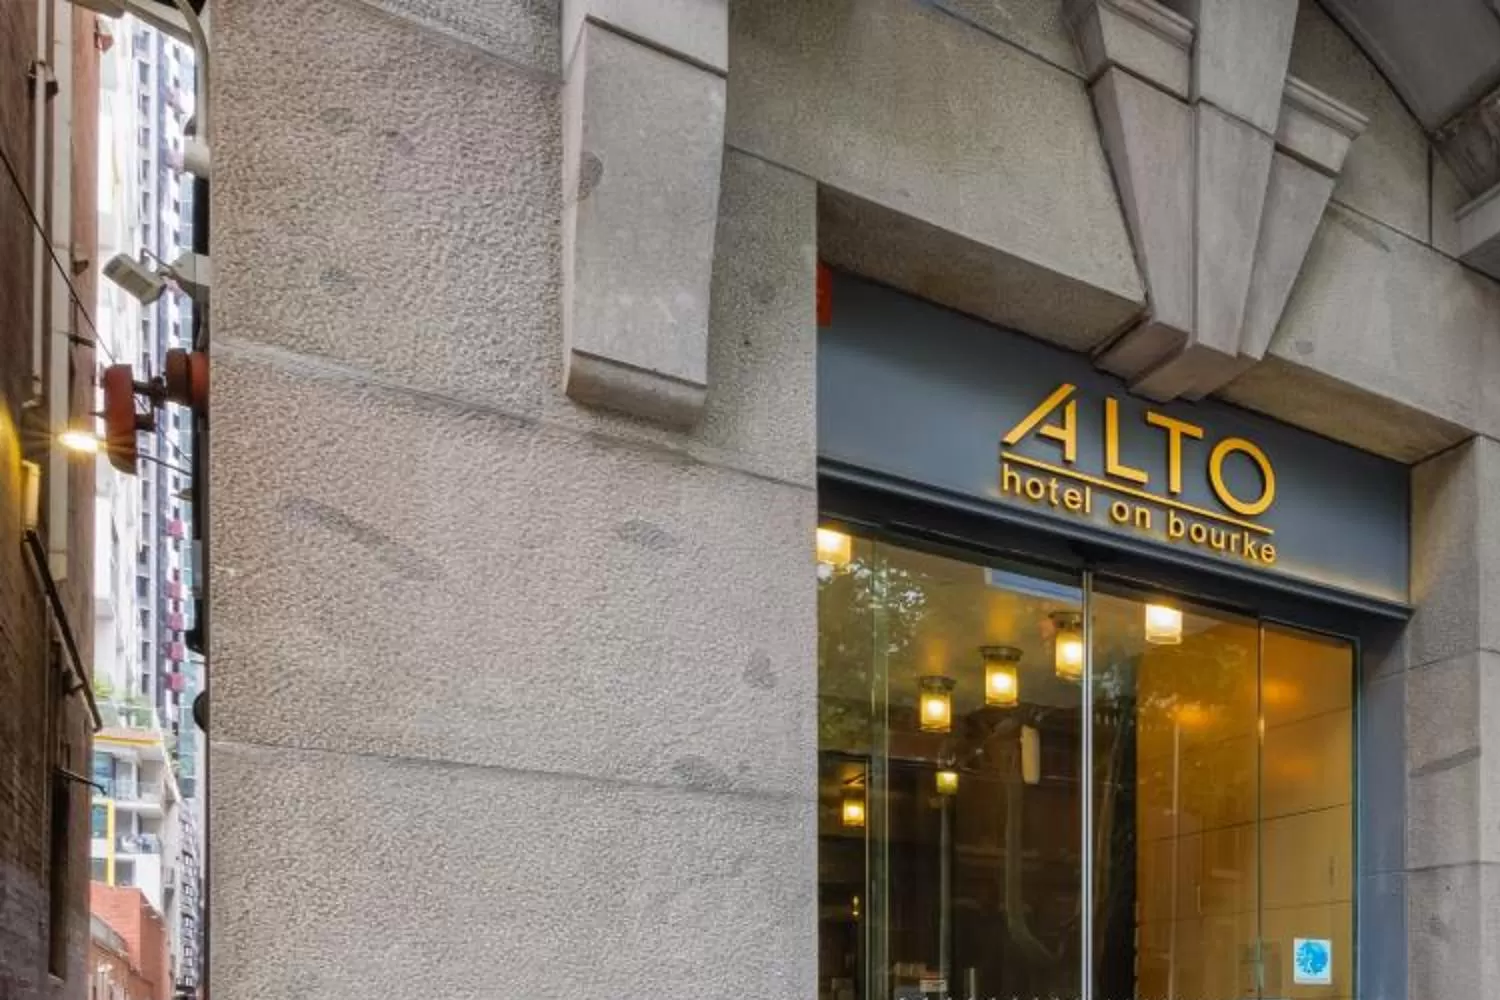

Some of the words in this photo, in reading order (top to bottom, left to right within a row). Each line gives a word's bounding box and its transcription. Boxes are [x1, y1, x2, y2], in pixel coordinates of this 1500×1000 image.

[1001, 383, 1277, 516] ALTO
[1002, 462, 1092, 513] hotel
[1111, 500, 1152, 529] on
[1168, 509, 1277, 564] bourke
